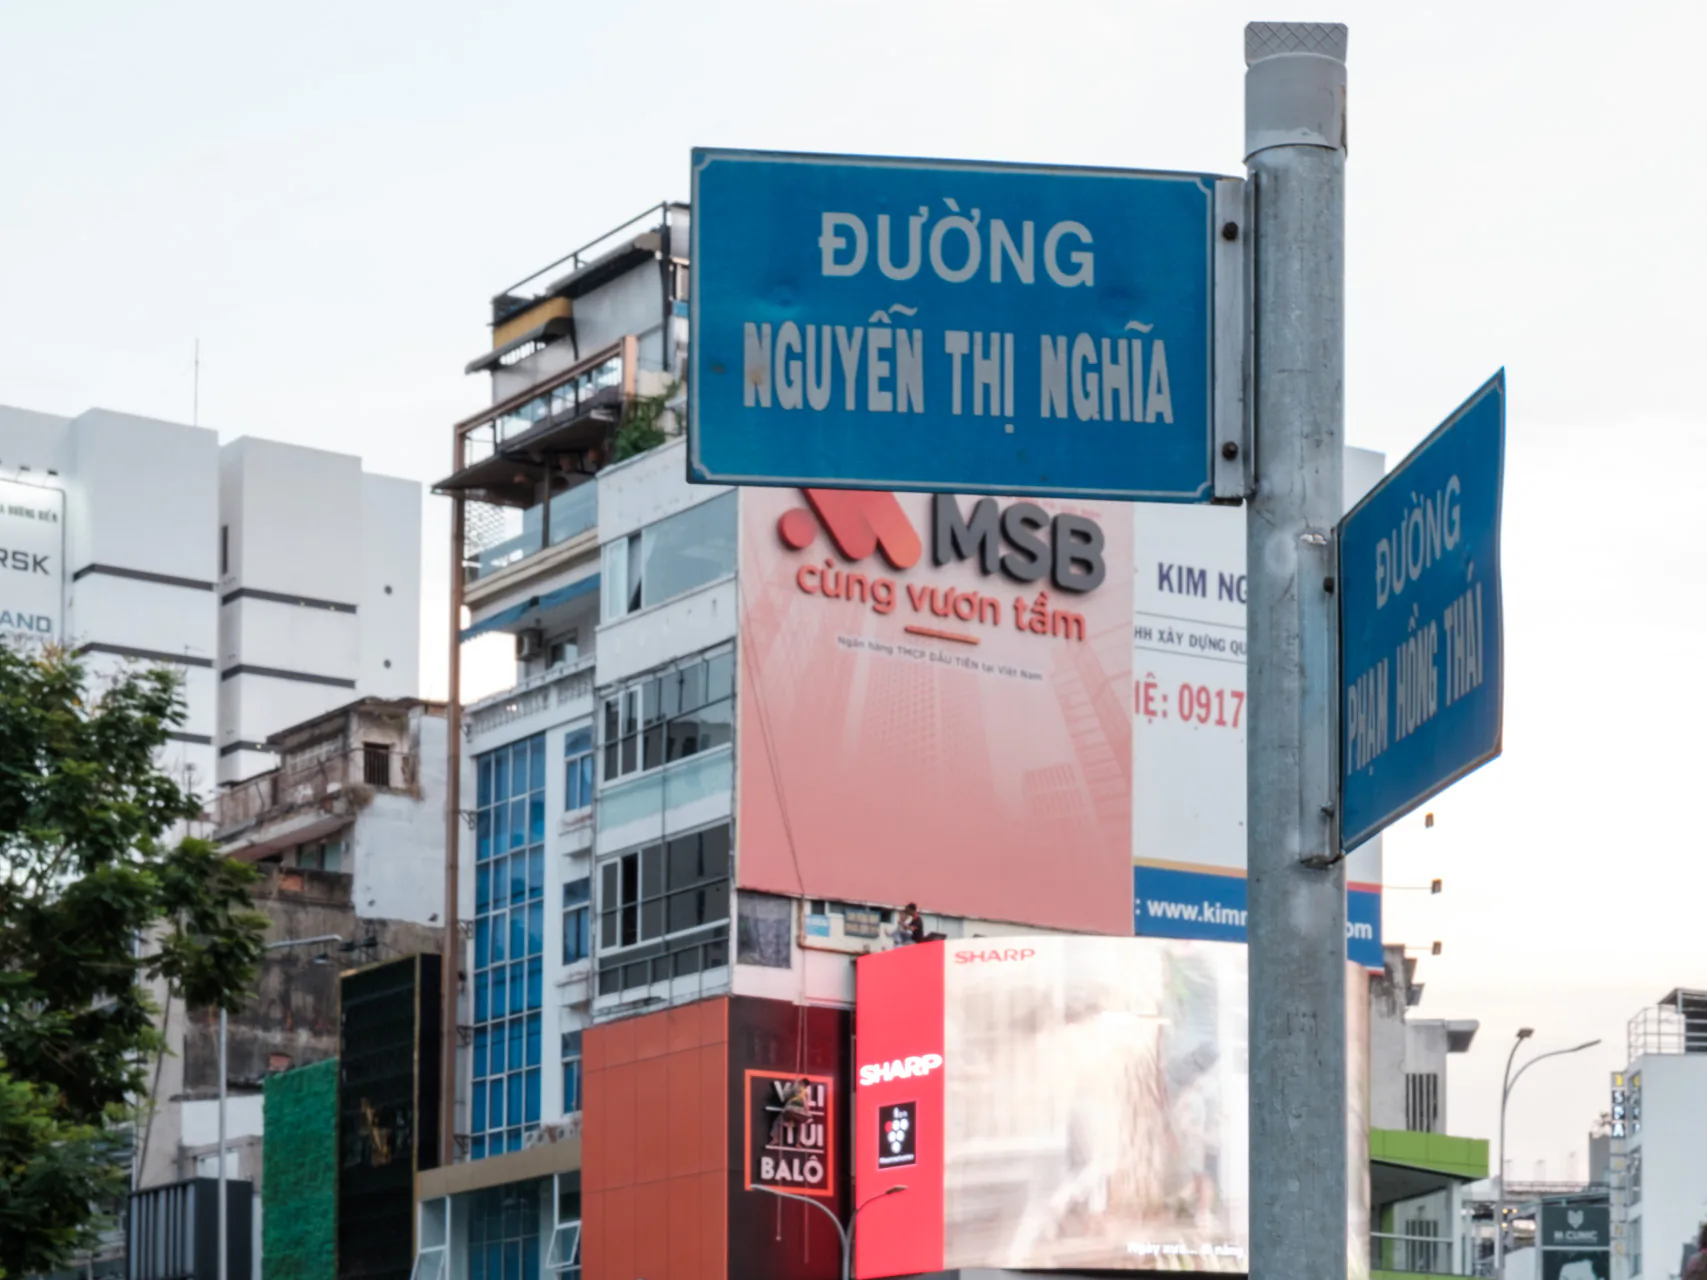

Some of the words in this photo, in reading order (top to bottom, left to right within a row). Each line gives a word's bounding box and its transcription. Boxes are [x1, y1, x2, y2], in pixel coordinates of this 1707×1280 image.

[818, 197, 1094, 287] ĐƯỜNG
[744, 303, 924, 413] NGUYỄN
[945, 330, 1014, 433] THỊ
[1041, 320, 1174, 424] NGHĨA
[931, 493, 1106, 594] MSB
[1158, 561, 1207, 599] KIM
[1375, 473, 1461, 610] ĐƯỜNG
[796, 558, 897, 616] cùng
[905, 582, 1002, 626] vươn
[1013, 591, 1087, 642] tầm
[1347, 657, 1389, 776] PHẠM
[1395, 602, 1438, 743] HỒNG
[1443, 561, 1483, 708] THÁI
[953, 948, 1036, 965] SHARP
[859, 1053, 943, 1087] SHARP
[760, 1155, 825, 1185] BALÔ
